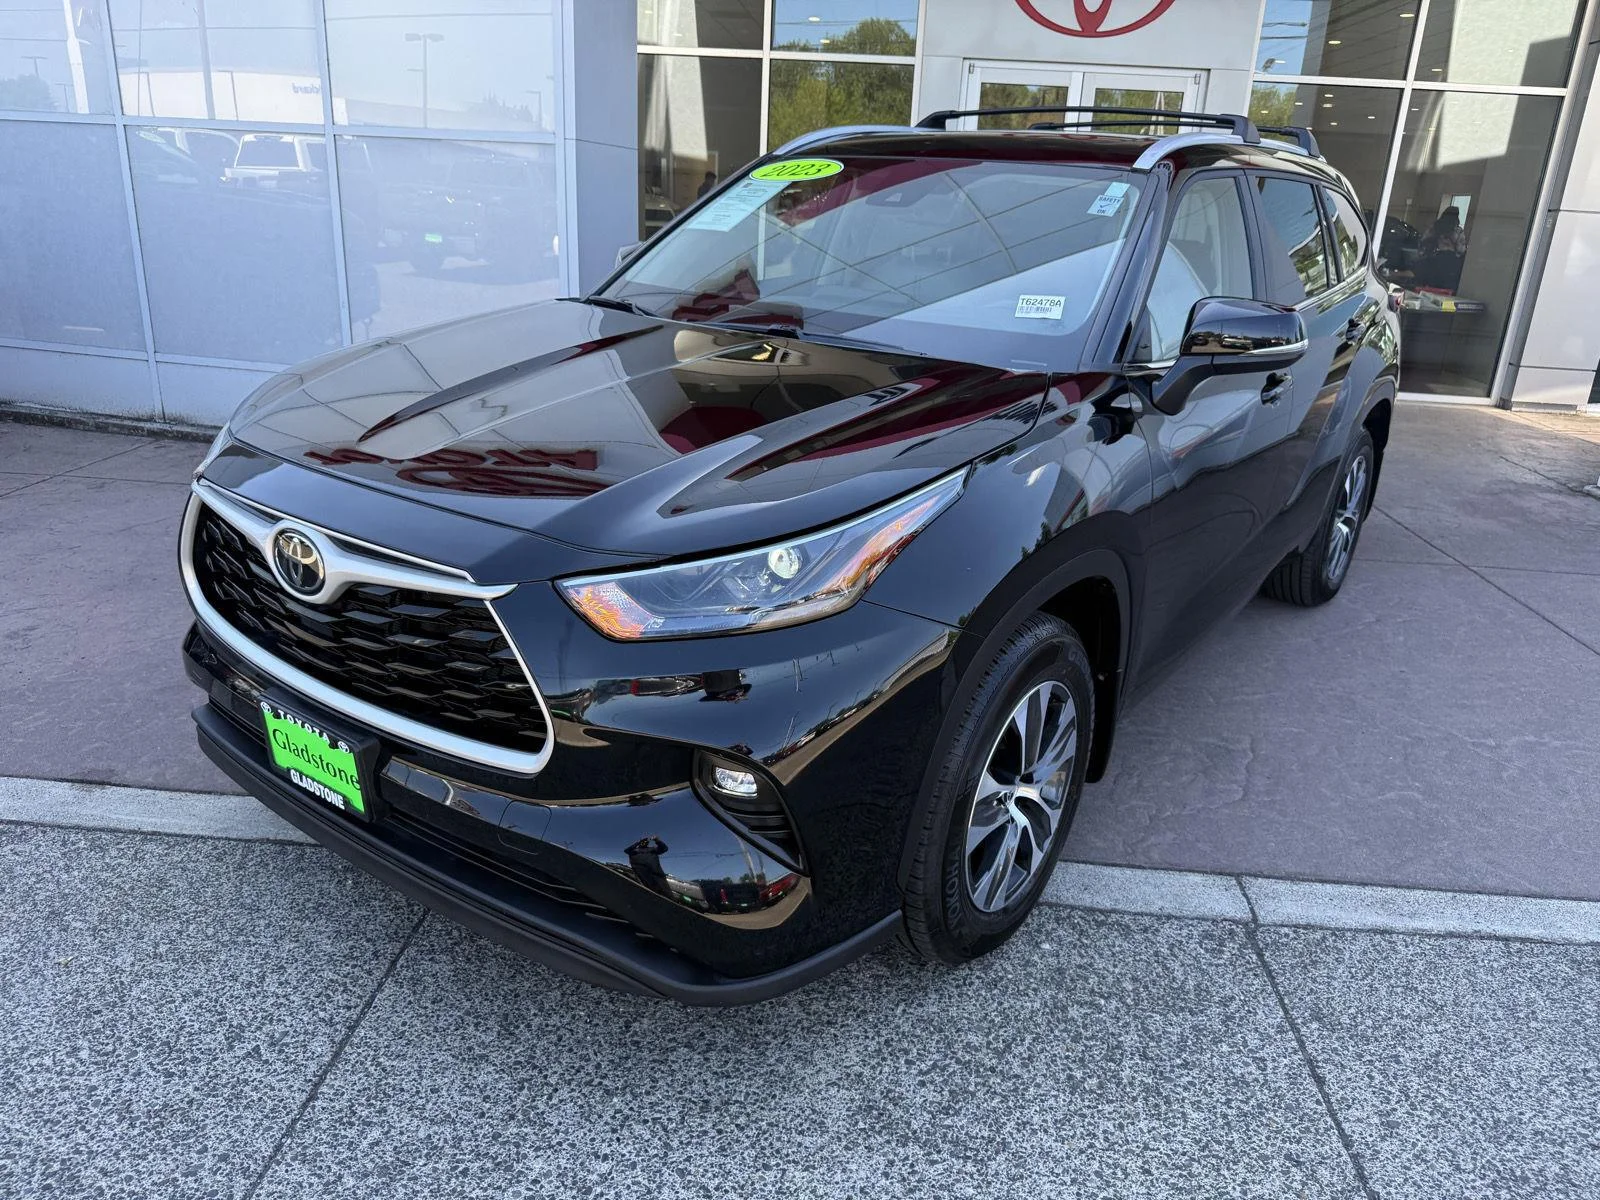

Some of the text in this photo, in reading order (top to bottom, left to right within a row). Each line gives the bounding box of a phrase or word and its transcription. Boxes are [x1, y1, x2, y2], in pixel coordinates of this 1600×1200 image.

[761, 163, 831, 178] 2023
[1020, 298, 1062, 307] T62478A
[278, 709, 330, 745] TOYOTA
[272, 728, 361, 791] Gladstone
[290, 769, 345, 810] GLADSTONE
